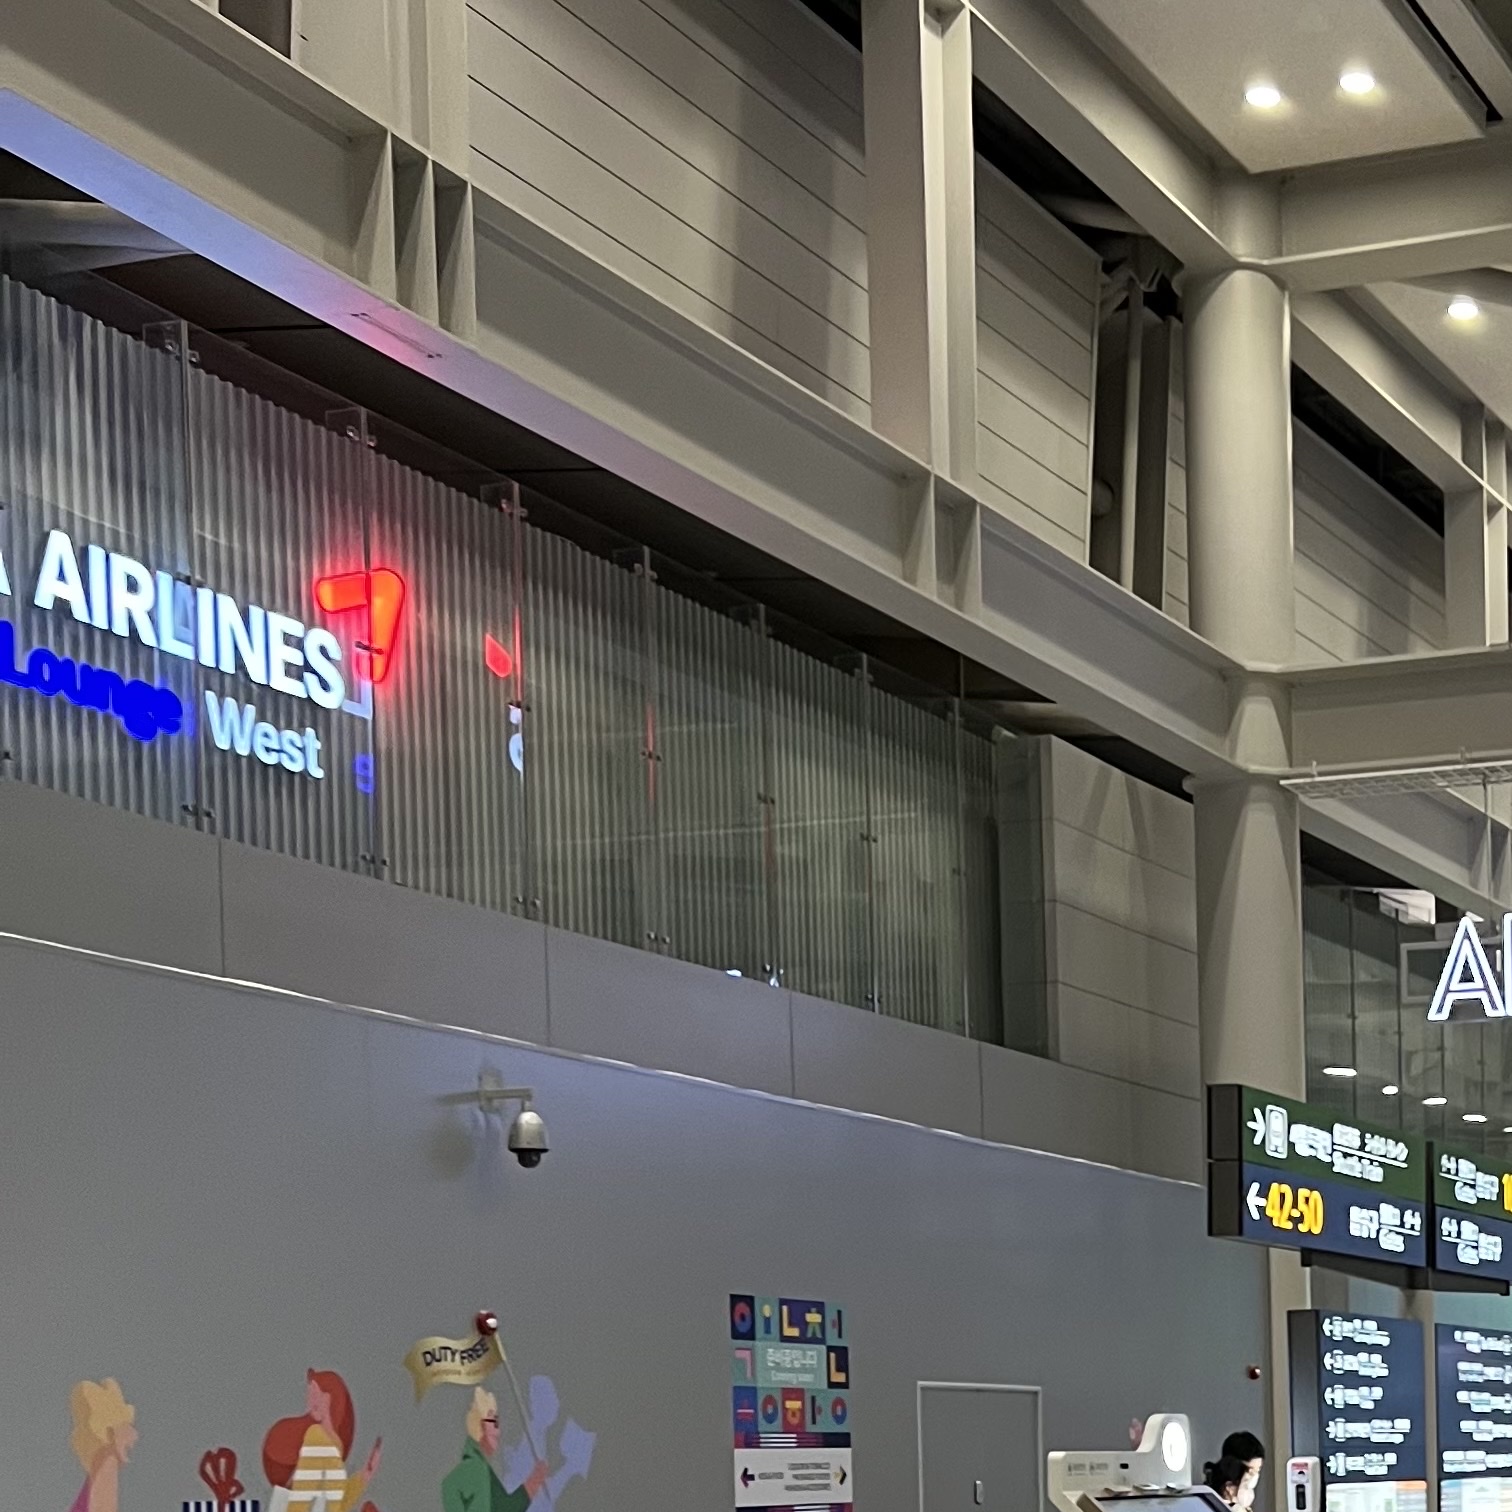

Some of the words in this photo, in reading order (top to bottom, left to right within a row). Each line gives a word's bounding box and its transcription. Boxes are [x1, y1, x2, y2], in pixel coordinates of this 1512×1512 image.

[34, 529, 346, 709] AIRLINES
[204, 690, 325, 780] West
[1265, 1182, 1325, 1235] 42-50
[422, 1346, 459, 1368] DUTY
[460, 1337, 491, 1366] FREE
